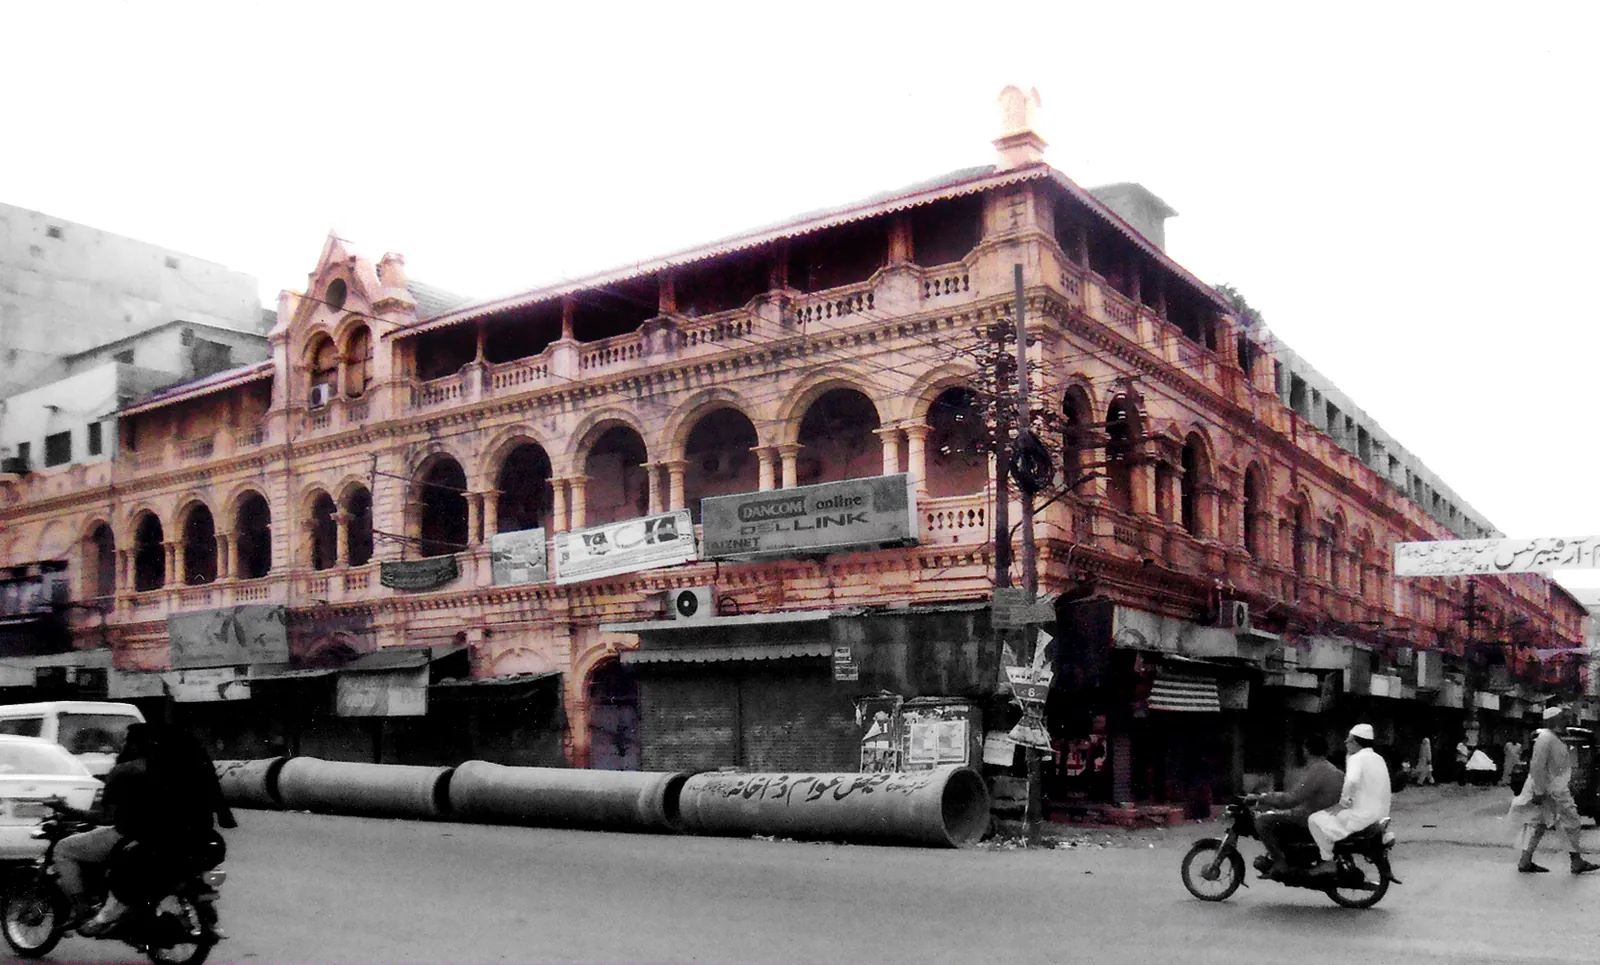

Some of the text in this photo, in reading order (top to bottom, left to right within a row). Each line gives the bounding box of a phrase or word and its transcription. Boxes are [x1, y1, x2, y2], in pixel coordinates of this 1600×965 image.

[742, 494, 863, 519] DANCOM online
[1028, 687, 1036, 698] 6
